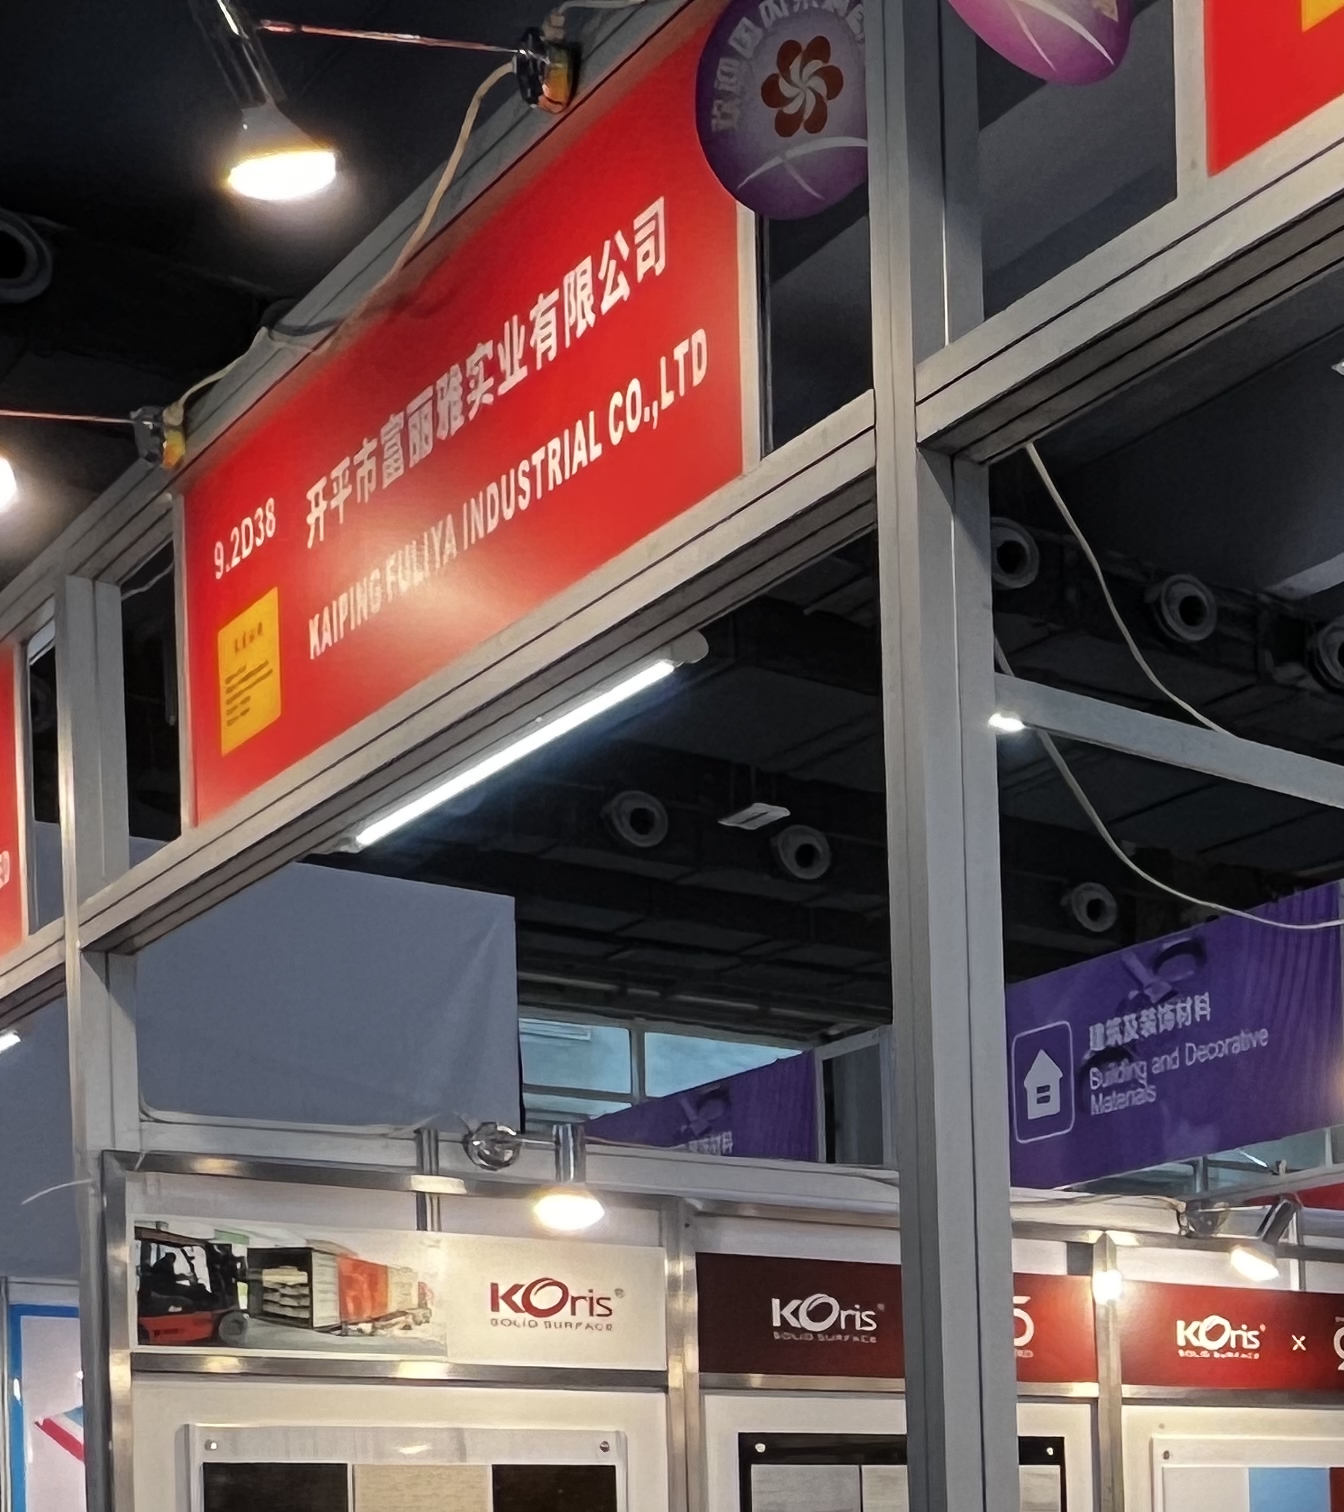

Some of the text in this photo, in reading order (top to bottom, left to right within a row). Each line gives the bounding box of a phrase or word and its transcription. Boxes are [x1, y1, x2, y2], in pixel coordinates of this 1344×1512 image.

[306, 196, 666, 549] 开平市富丽雅实业有限公司
[214, 497, 276, 579] 9.2D38
[309, 568, 382, 660] KAIPING
[386, 513, 457, 603] FULIYA
[463, 410, 602, 550] INDUSTRIAL
[1152, 1047, 1180, 1074] and
[1185, 1028, 1269, 1066] Decorative
